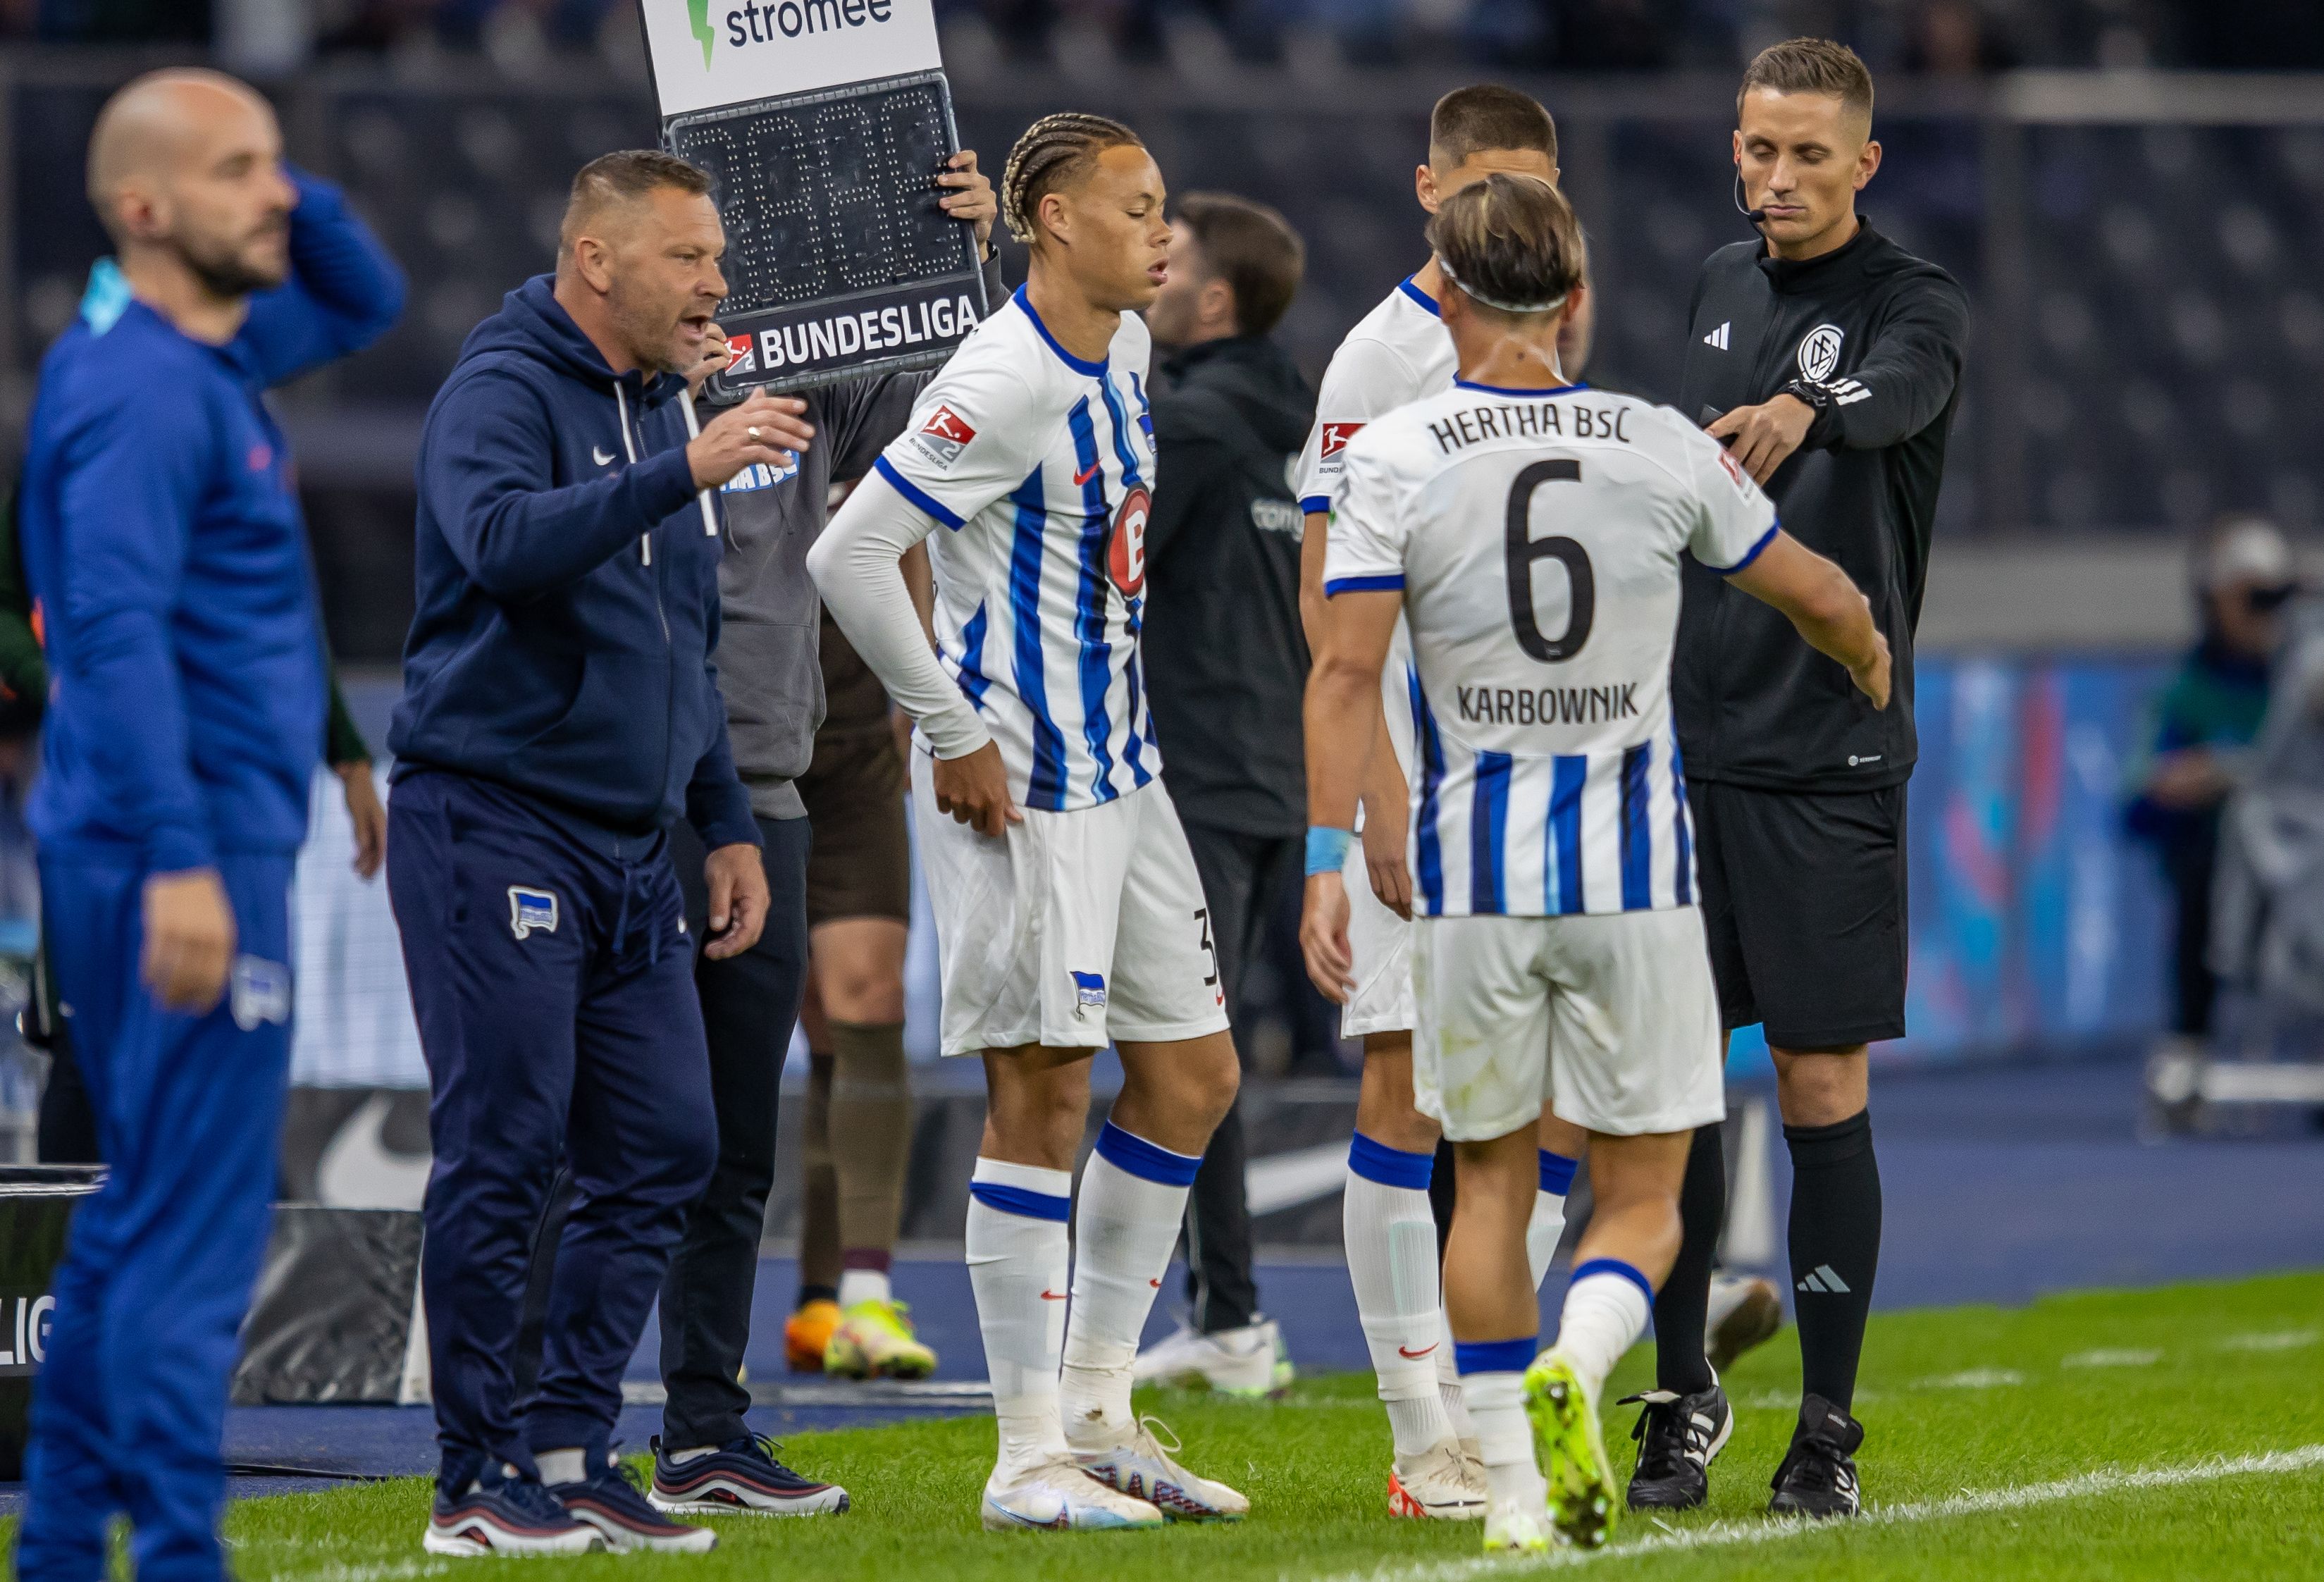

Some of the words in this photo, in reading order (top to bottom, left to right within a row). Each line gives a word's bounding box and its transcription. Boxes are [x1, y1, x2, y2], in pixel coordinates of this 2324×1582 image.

[727, 0, 891, 47] stromee
[760, 295, 980, 369] BUNDESLIGA
[941, 441, 960, 459] 2
[1428, 404, 1562, 455] HERTHA
[1572, 405, 1632, 444] BSC
[908, 438, 948, 471] BUNDESLIGA
[1504, 459, 1595, 664] 6
[1457, 682, 1639, 726] KARBOWNIK
